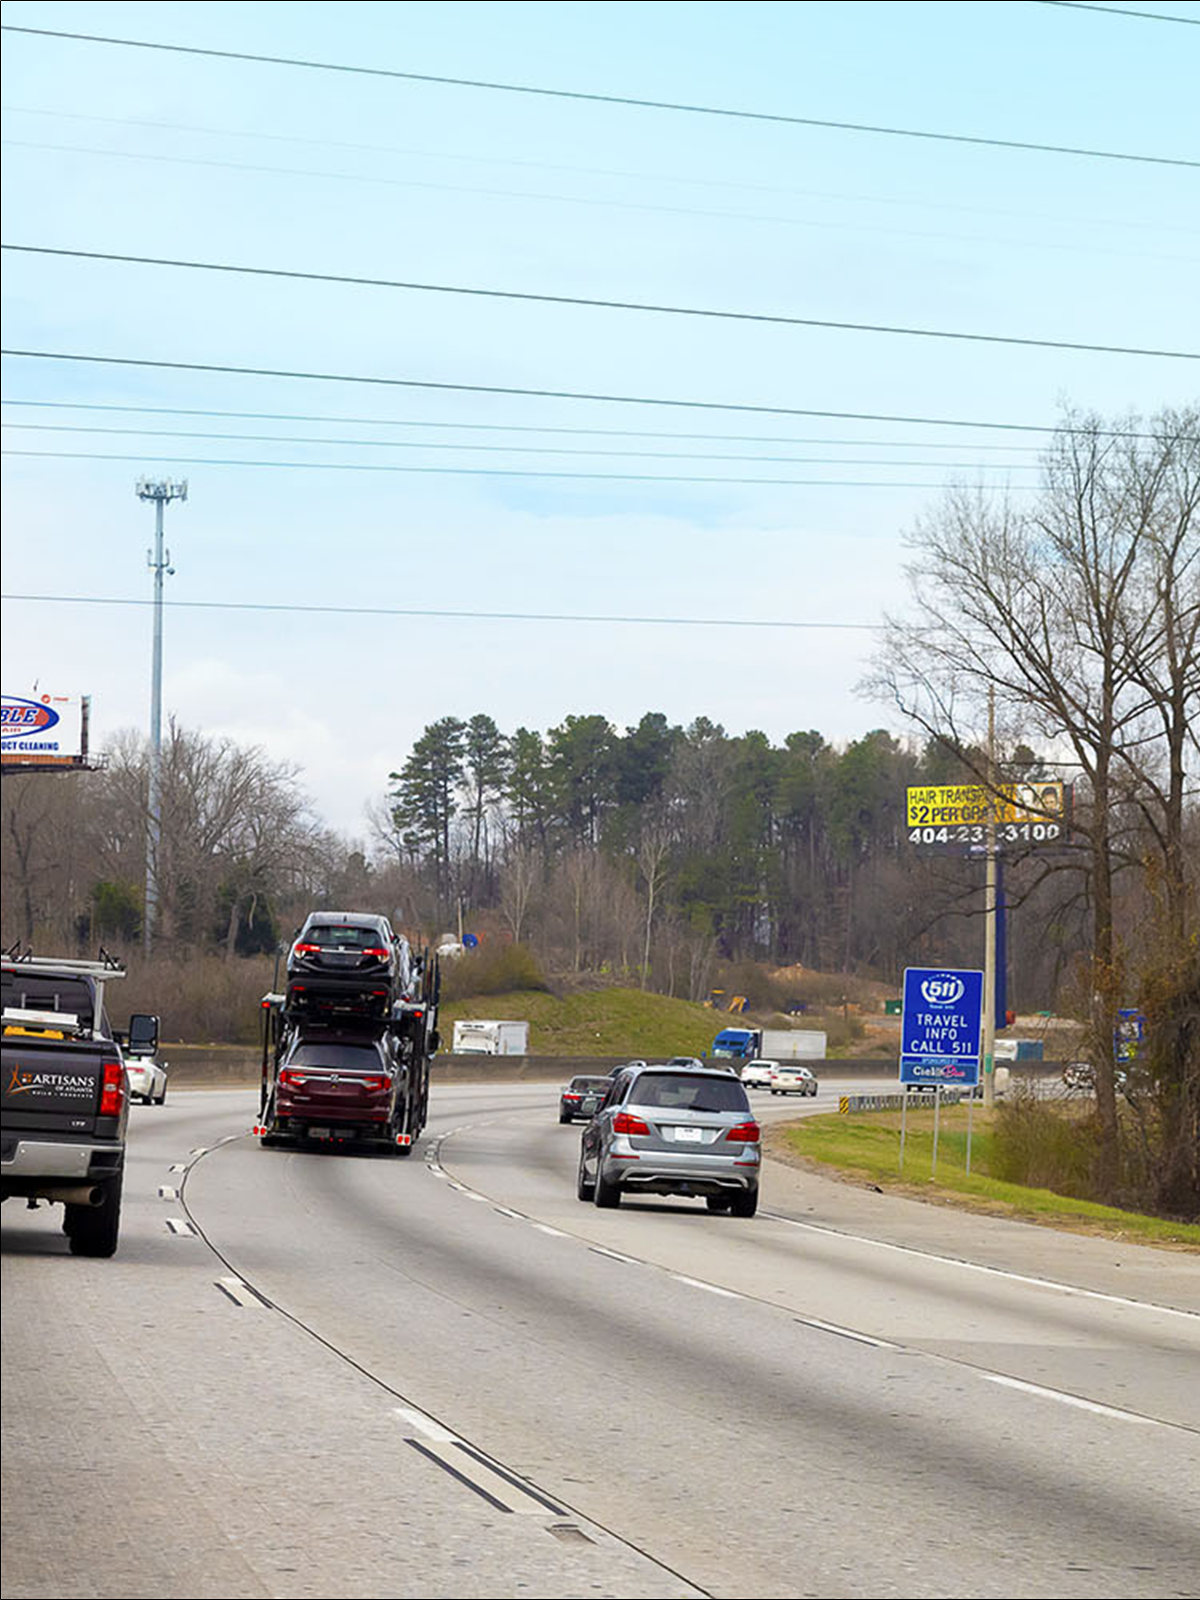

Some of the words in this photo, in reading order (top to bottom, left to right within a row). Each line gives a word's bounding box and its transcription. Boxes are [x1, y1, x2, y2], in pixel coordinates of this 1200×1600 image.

[19, 741, 59, 751] CLEANING
[910, 790, 936, 804] HAIR
[910, 806, 929, 823] $2
[932, 807, 958, 822] PER
[909, 824, 1060, 844] 404-23-3100
[929, 981, 956, 996] 511
[917, 1013, 968, 1027] TRAVEL
[926, 1028, 957, 1040] INFO
[911, 1040, 944, 1053] CALL
[952, 1042, 972, 1053] 511
[33, 1074, 95, 1087] ARTISANS
